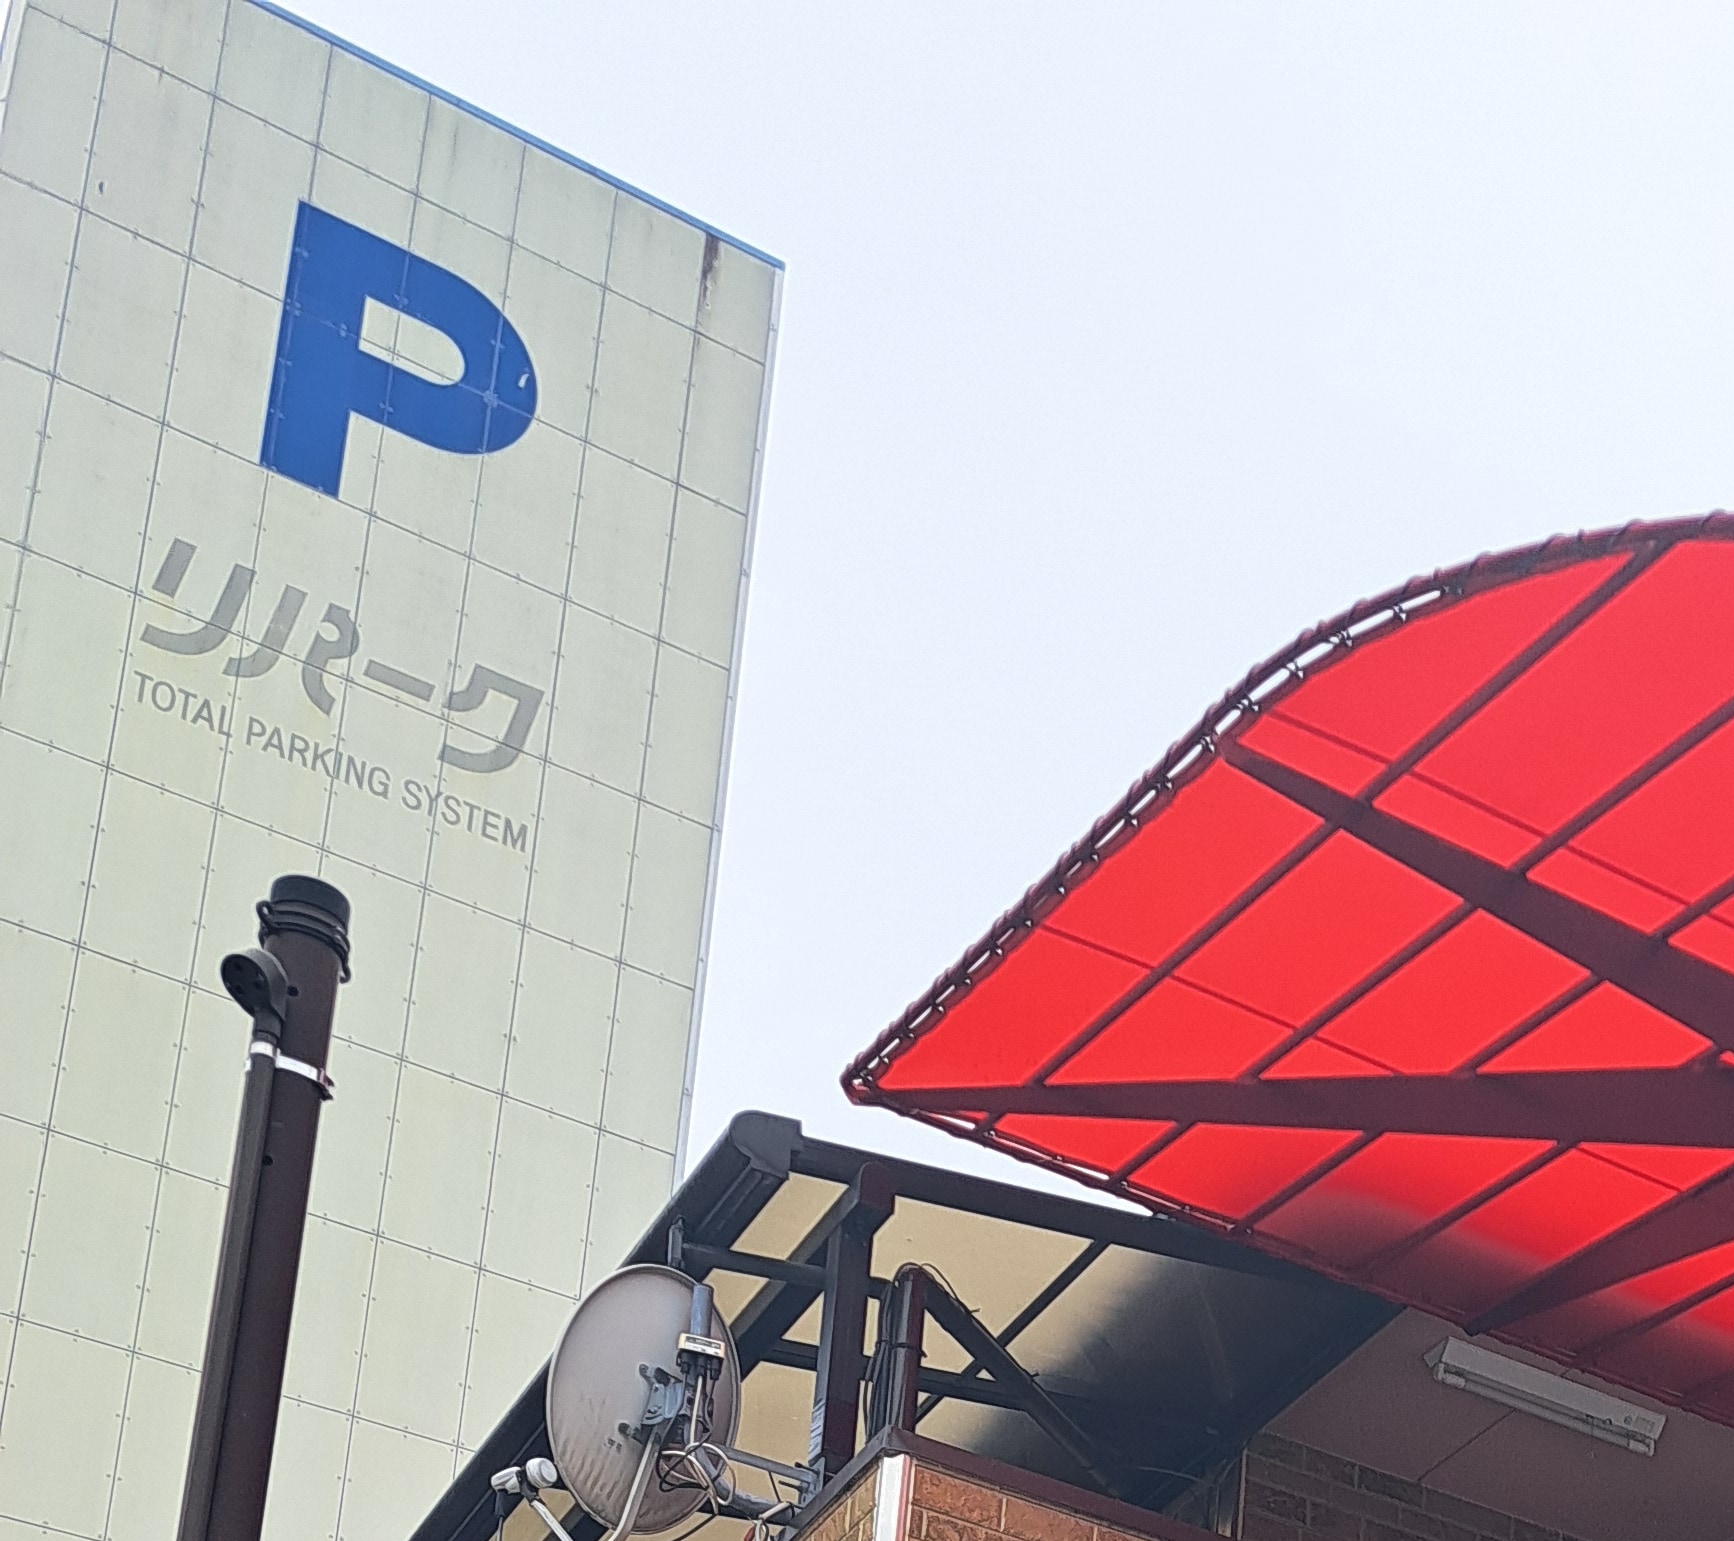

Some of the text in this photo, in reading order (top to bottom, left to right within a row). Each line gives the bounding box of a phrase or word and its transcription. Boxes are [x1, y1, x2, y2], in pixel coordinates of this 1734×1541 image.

[259, 199, 538, 498] P
[134, 669, 529, 854] TOTAL PARKING SYSTEM
[140, 538, 545, 775] リパーク
